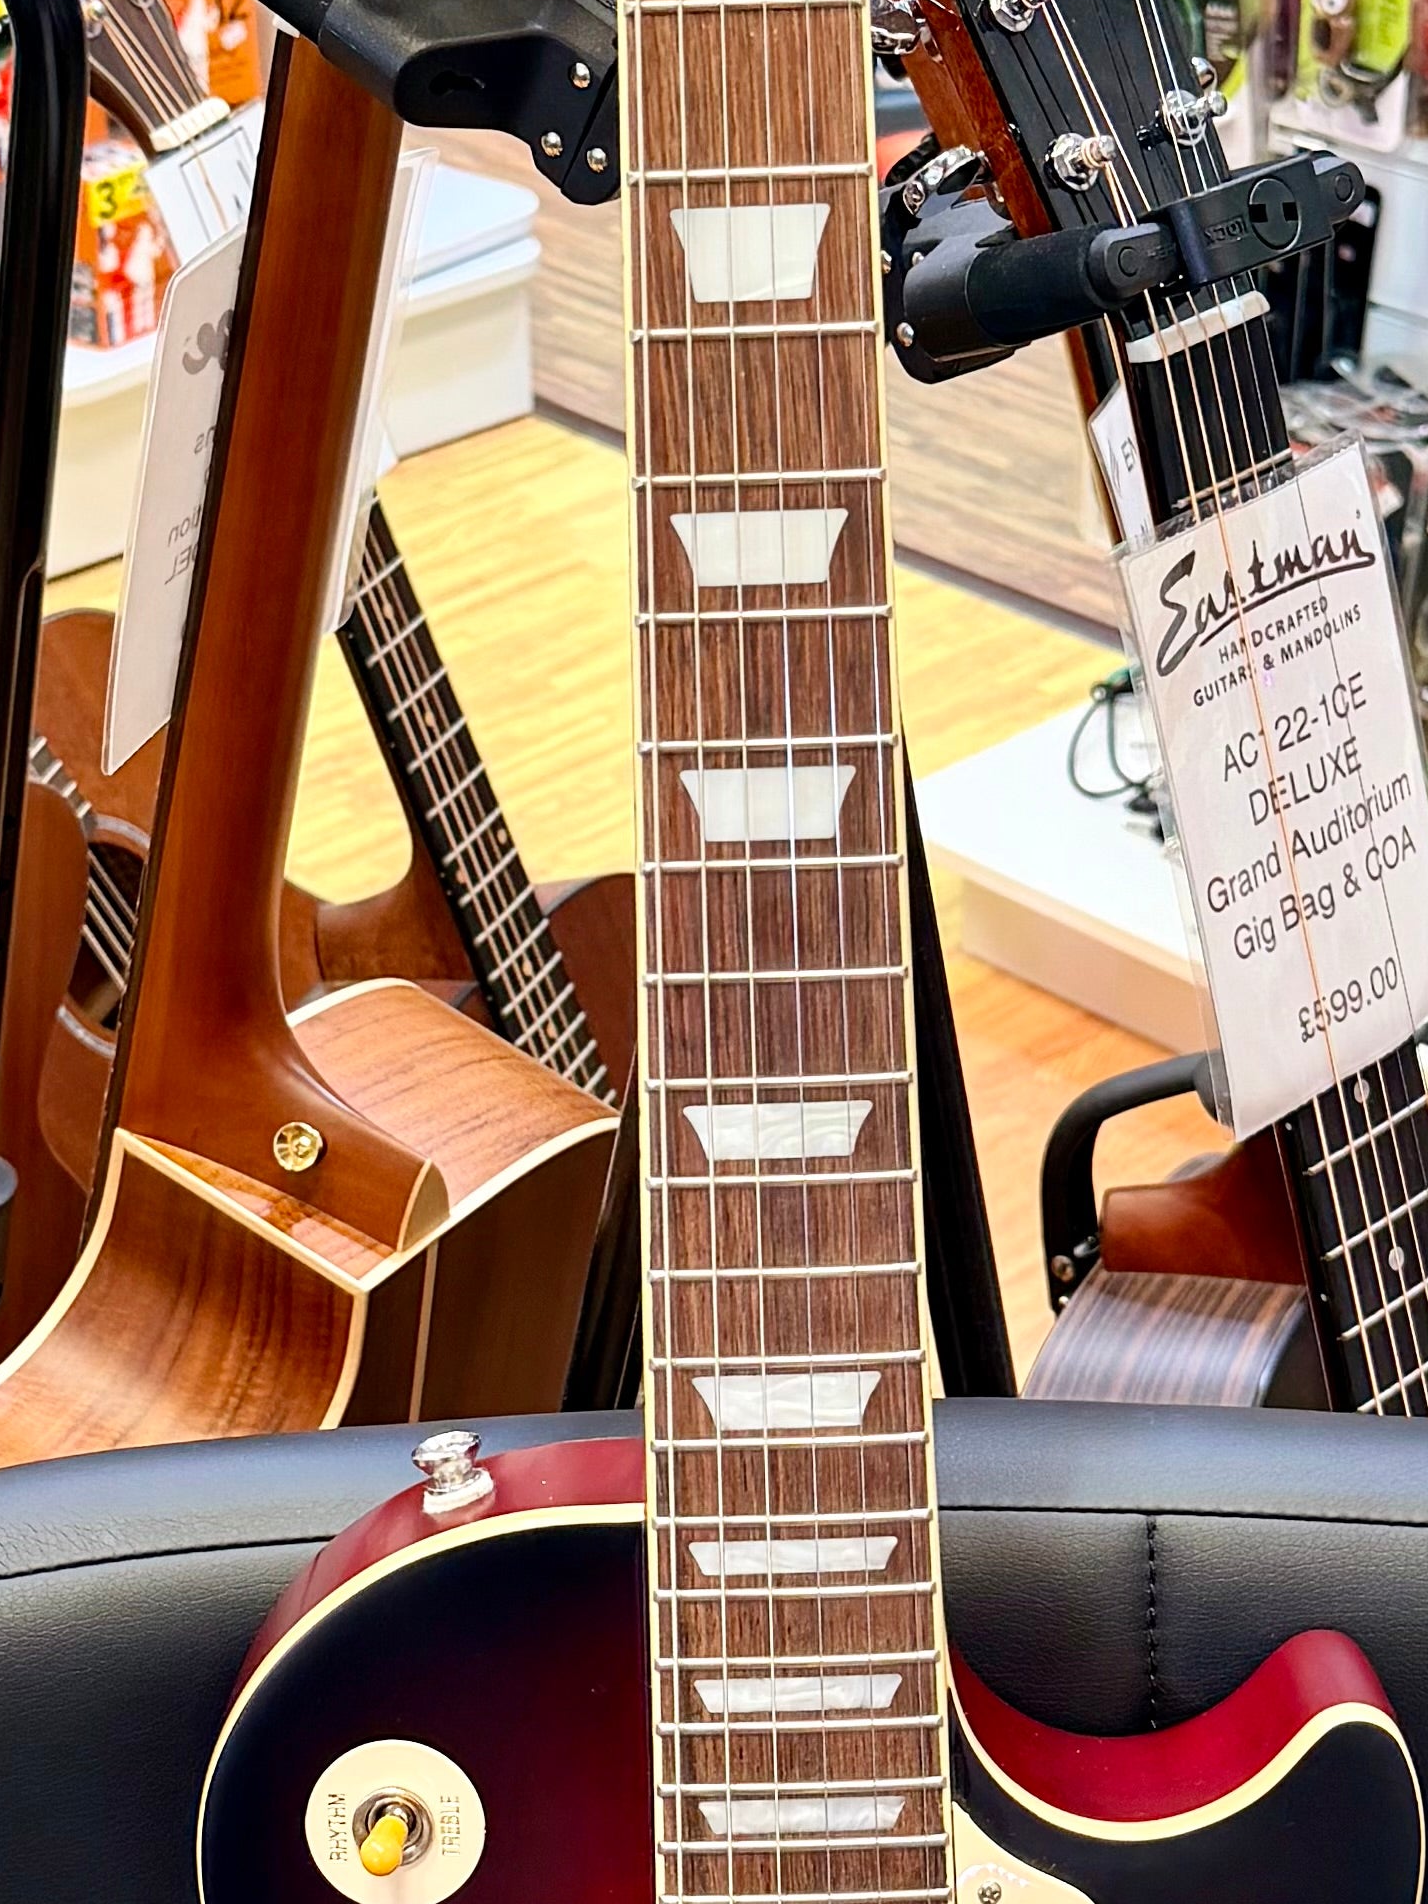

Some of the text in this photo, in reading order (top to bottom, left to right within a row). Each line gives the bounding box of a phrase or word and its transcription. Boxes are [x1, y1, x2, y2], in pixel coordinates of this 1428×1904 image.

[97, 181, 118, 219] 3
[1156, 529, 1376, 677] Eastman
[1218, 596, 1328, 664] HANDCRAFTED
[1262, 654, 1275, 671] &
[1280, 604, 1361, 664] MANDOLINS
[1224, 671, 1367, 782] AC22-1CE
[1248, 736, 1362, 826] DELUXE
[1207, 772, 1412, 913] Grand Auditorium
[1233, 825, 1417, 960] Gig Bag & COA
[1298, 956, 1398, 1043] £599.00
[328, 1793, 347, 1862] RHYTHM
[440, 1796, 460, 1857] TREBLE
